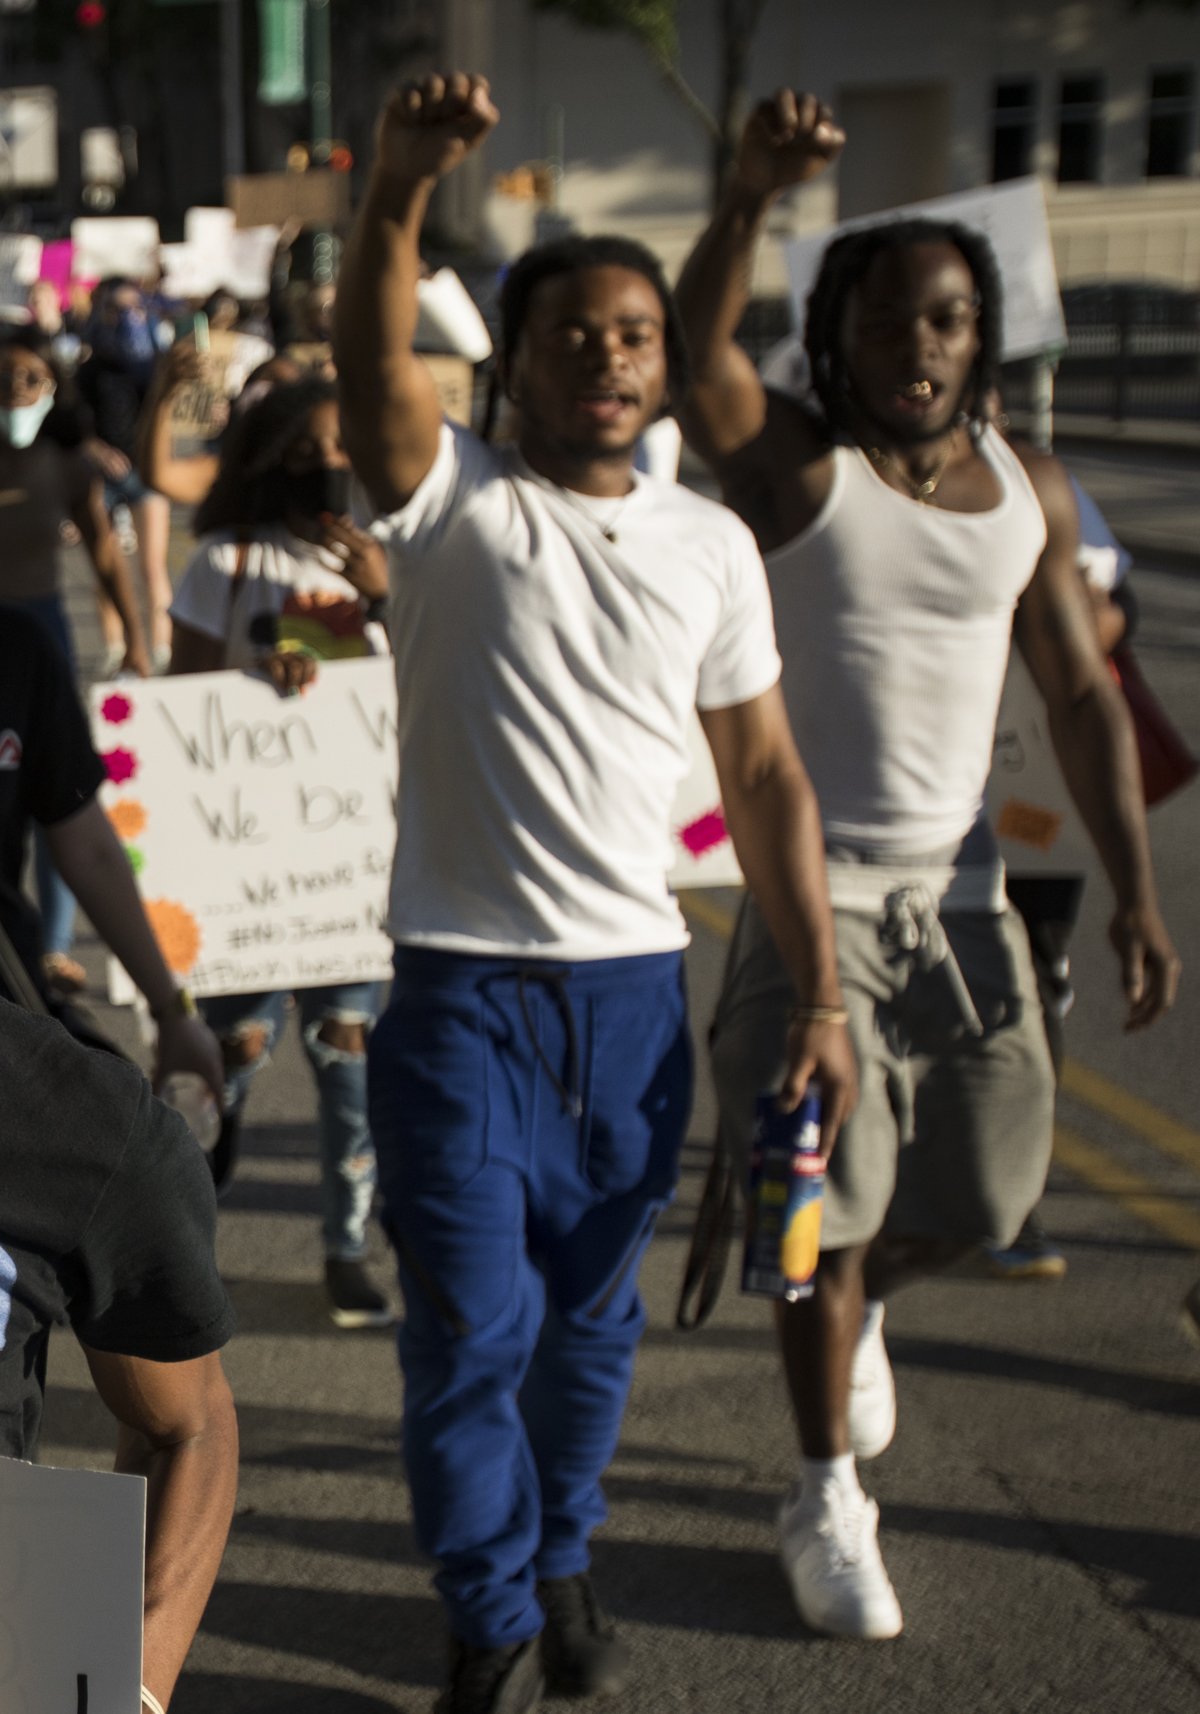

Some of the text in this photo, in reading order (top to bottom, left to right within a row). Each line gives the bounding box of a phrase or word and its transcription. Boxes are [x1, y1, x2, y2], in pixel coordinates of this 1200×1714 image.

[156, 690, 319, 772] When
[191, 786, 270, 845] We
[295, 781, 369, 833] be
